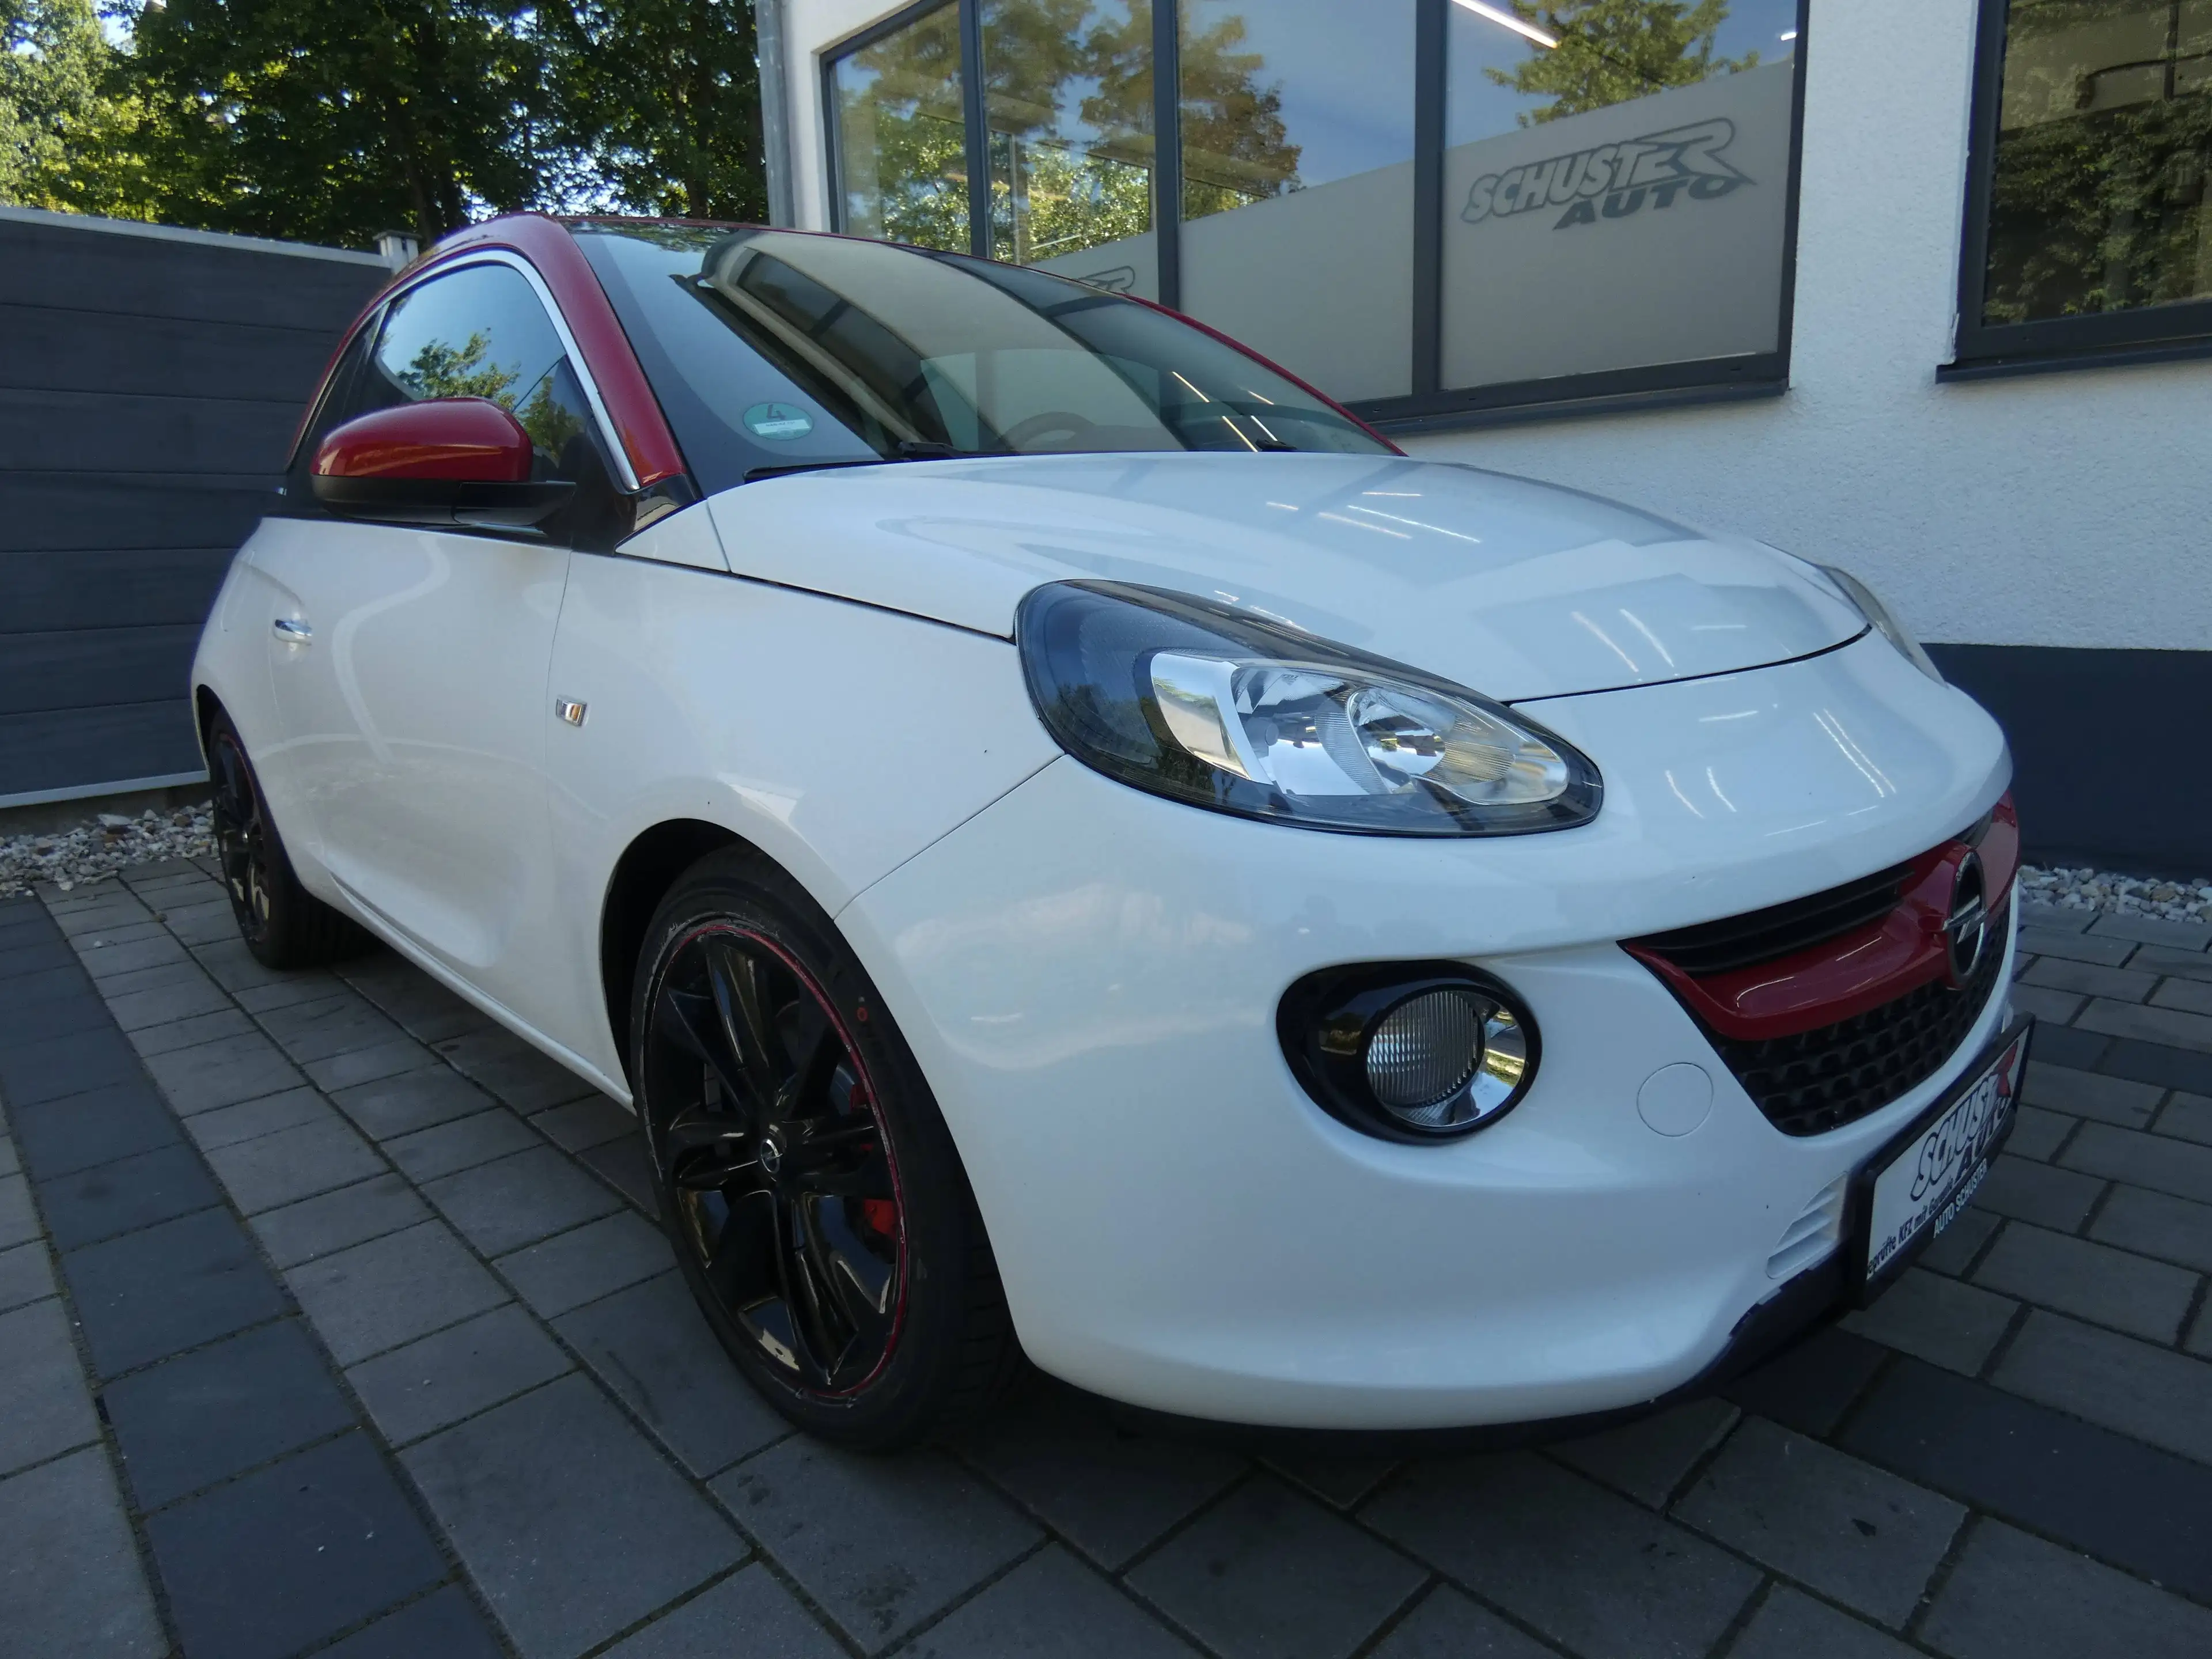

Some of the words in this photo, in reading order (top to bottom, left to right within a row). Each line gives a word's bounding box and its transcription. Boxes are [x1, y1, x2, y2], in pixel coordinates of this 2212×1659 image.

[1460, 117, 1758, 225] SCHUSTER
[1552, 176, 1735, 231] AUTO
[766, 404, 786, 421] 4
[1933, 1202, 1955, 1238] AUTO
[1956, 1157, 1987, 1212] SCHUSTER
